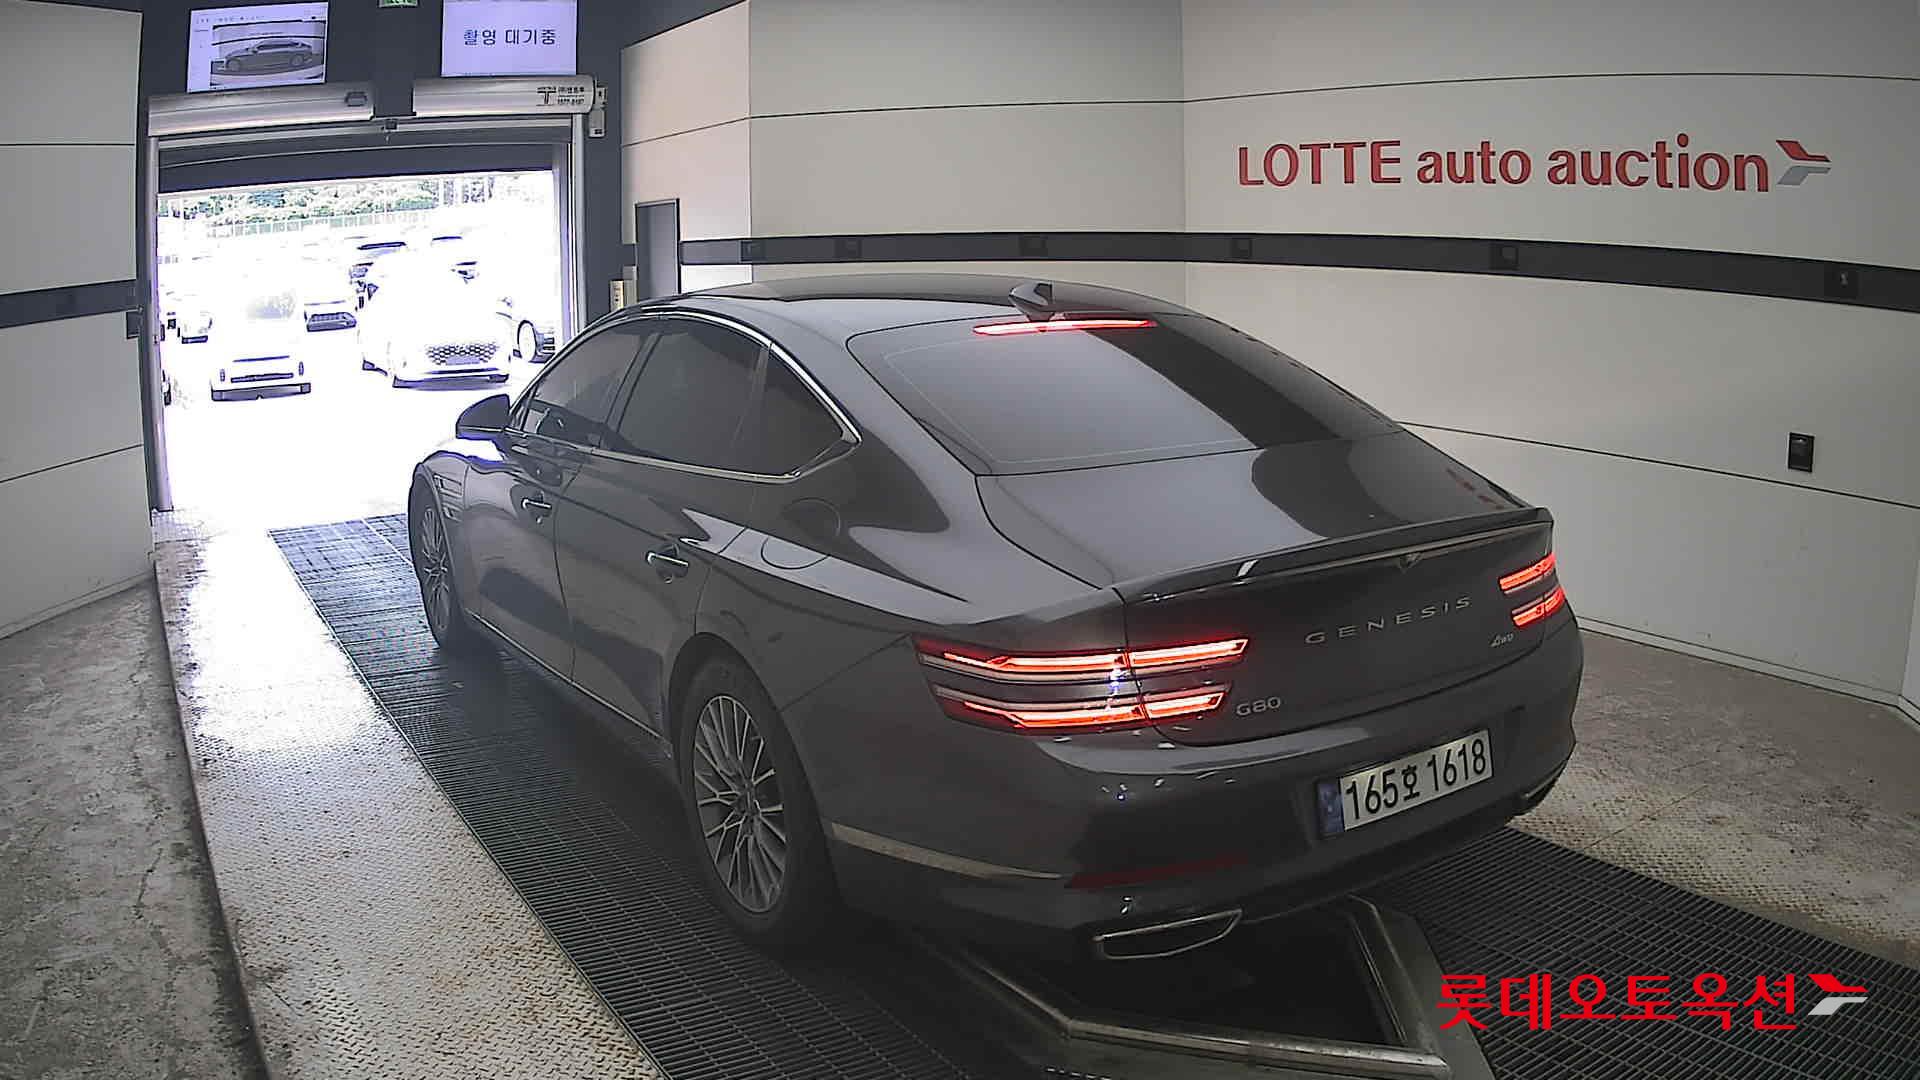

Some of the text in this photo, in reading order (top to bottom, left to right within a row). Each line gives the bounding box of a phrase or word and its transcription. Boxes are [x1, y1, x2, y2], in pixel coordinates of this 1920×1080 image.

[464, 29, 556, 45] 촬영 대기중
[1240, 133, 1769, 193] LOTTE auto auction
[1305, 597, 1470, 644] GENESIS
[1236, 697, 1281, 716] G80
[1345, 738, 1487, 820] 165호 1618
